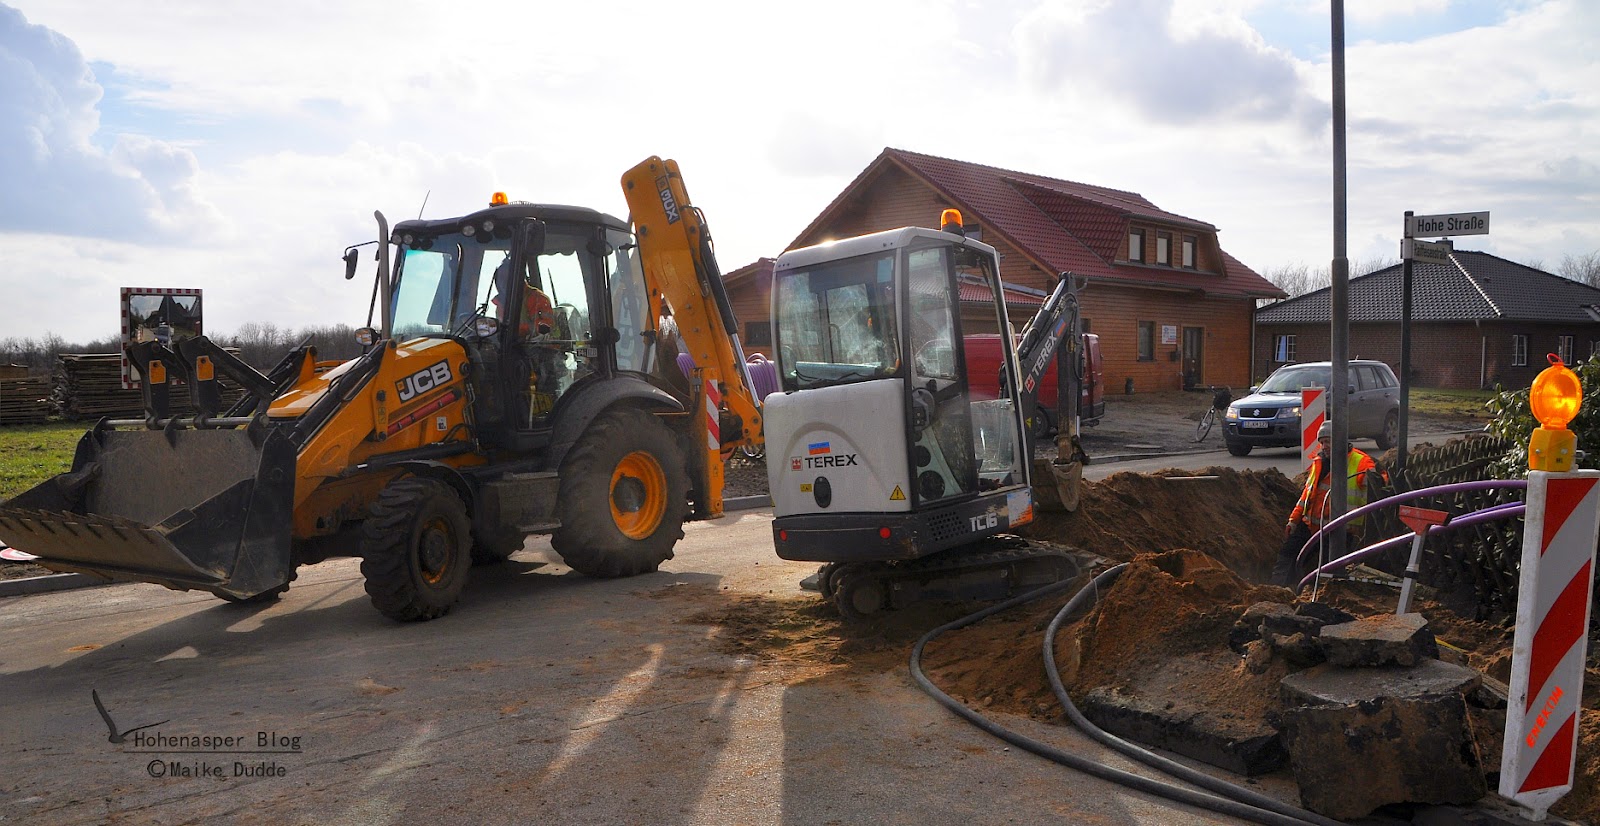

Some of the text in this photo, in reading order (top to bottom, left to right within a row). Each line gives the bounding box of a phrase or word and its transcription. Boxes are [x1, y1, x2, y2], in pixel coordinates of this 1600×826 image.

[660, 189, 679, 221] 3CX
[1417, 216, 1484, 232] Hohe Straße
[1031, 331, 1057, 376] TEREX
[399, 361, 451, 401] JCB
[804, 453, 858, 469] TEREX
[969, 512, 998, 532] TC16
[1526, 686, 1564, 749] ENEKOM
